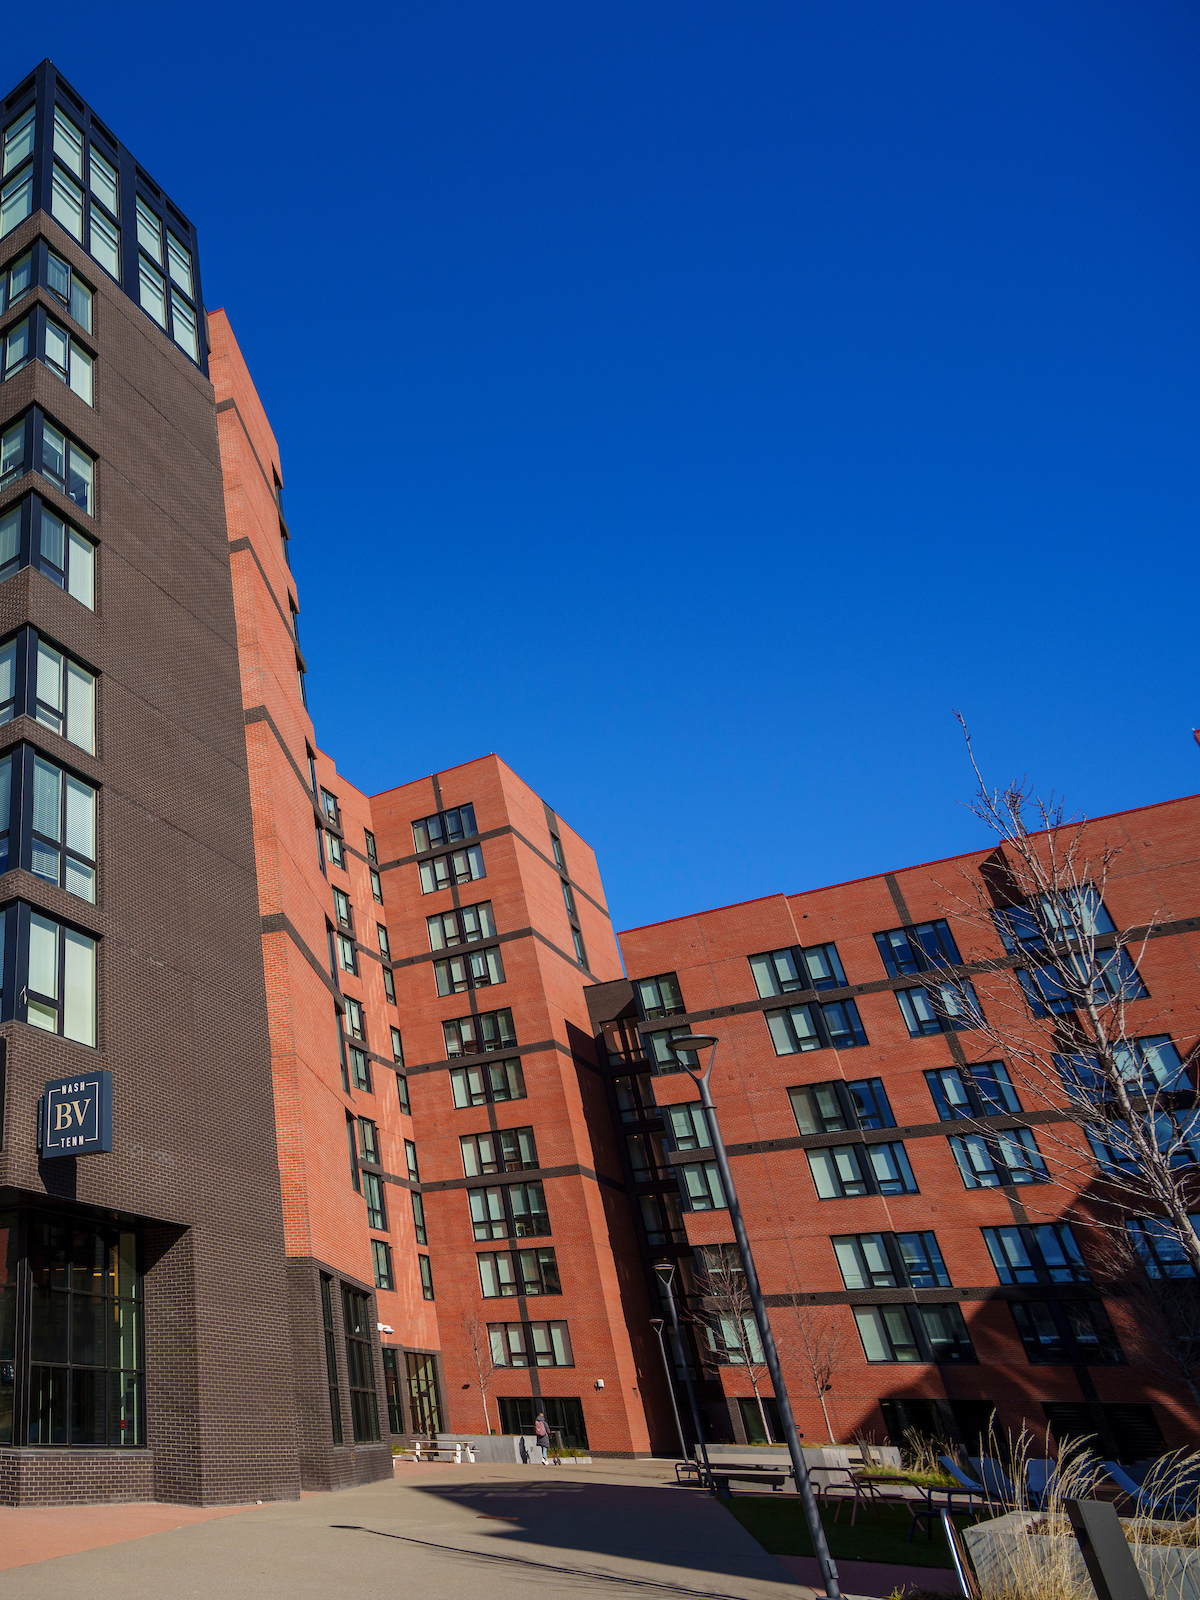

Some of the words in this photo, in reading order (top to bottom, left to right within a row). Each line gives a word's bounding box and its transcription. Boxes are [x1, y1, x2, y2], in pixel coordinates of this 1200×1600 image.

[62, 1081, 85, 1095] NASH
[54, 1098, 91, 1131] BV
[61, 1135, 84, 1148] TENN
